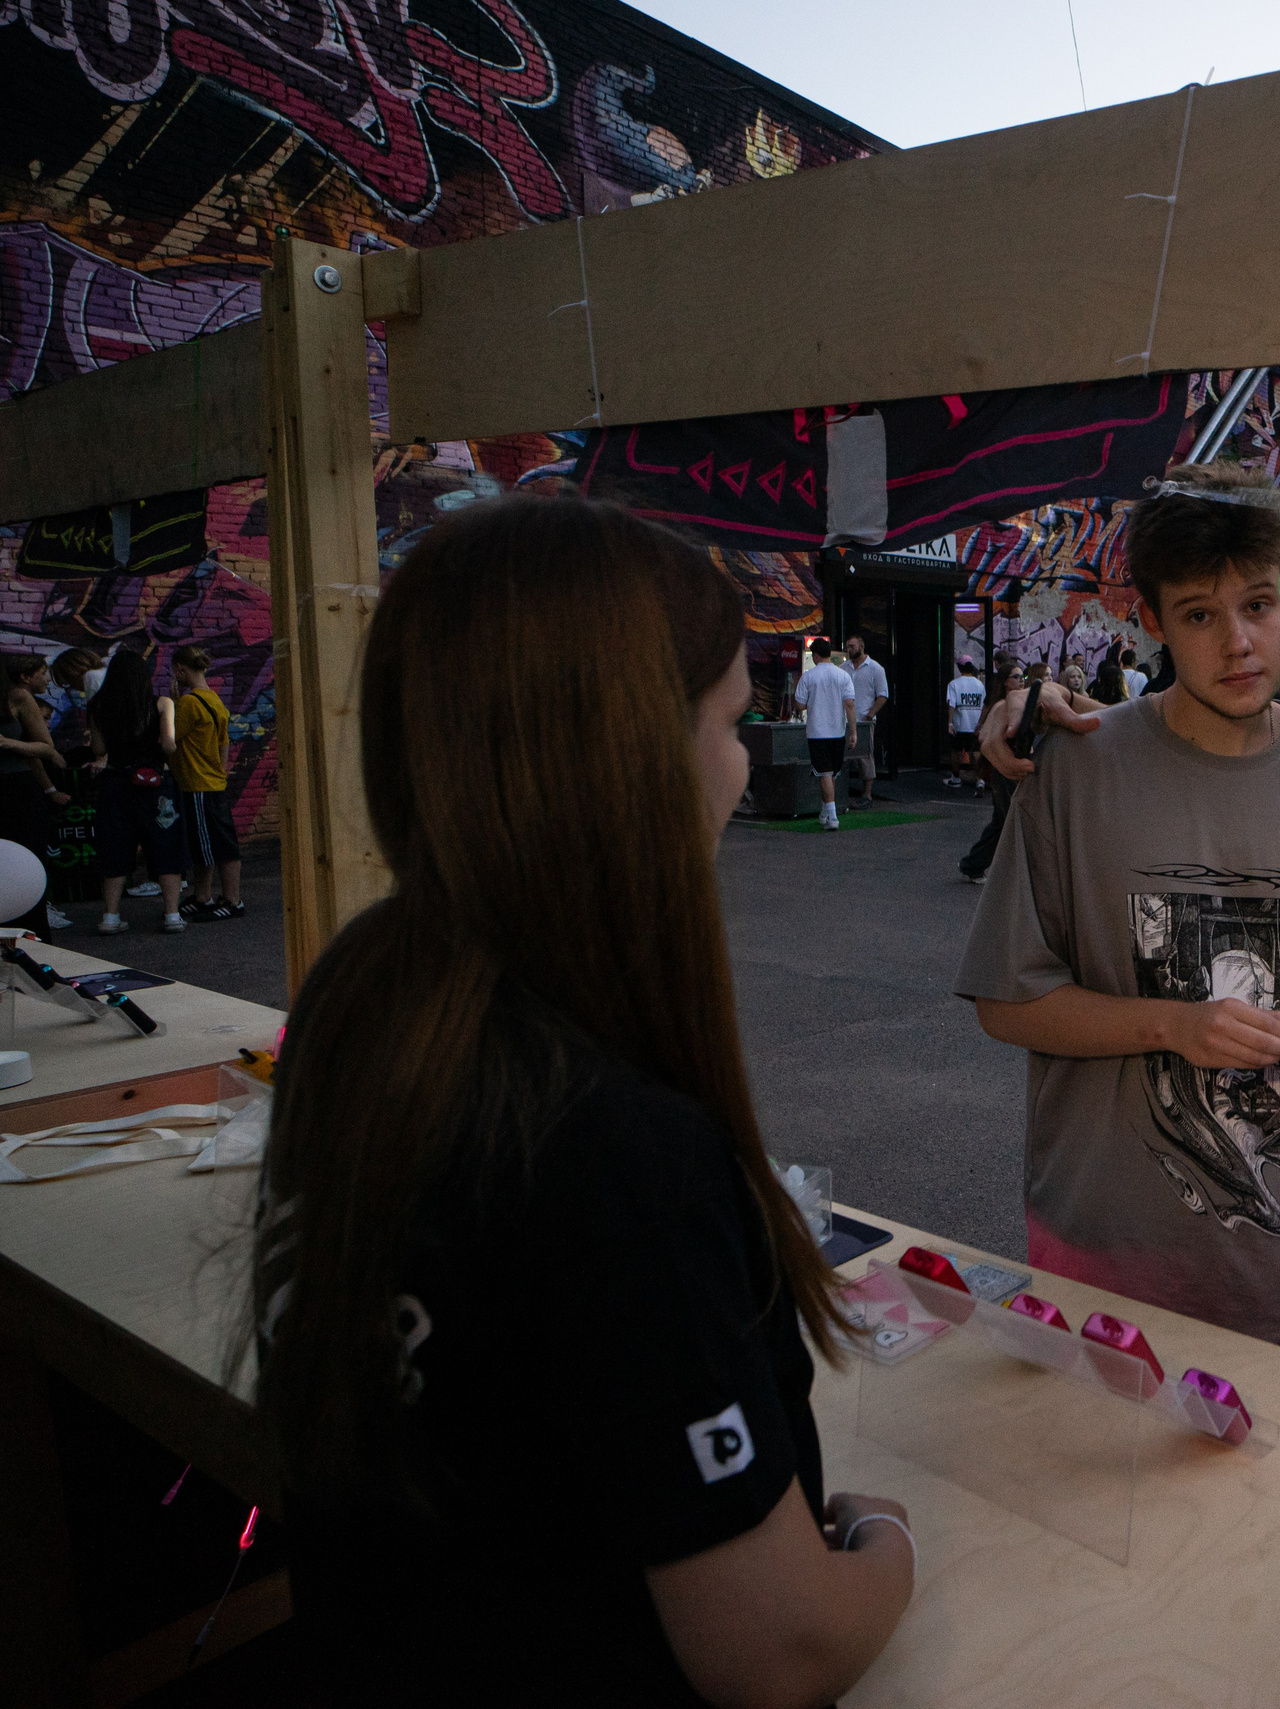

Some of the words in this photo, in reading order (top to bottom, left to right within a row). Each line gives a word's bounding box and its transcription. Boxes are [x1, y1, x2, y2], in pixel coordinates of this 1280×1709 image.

[862, 553, 884, 563] ВХОД
[886, 555, 892, 563] В
[893, 555, 951, 569] ГАСТРОКВАРТАЛ
[58, 826, 86, 840] IFE
